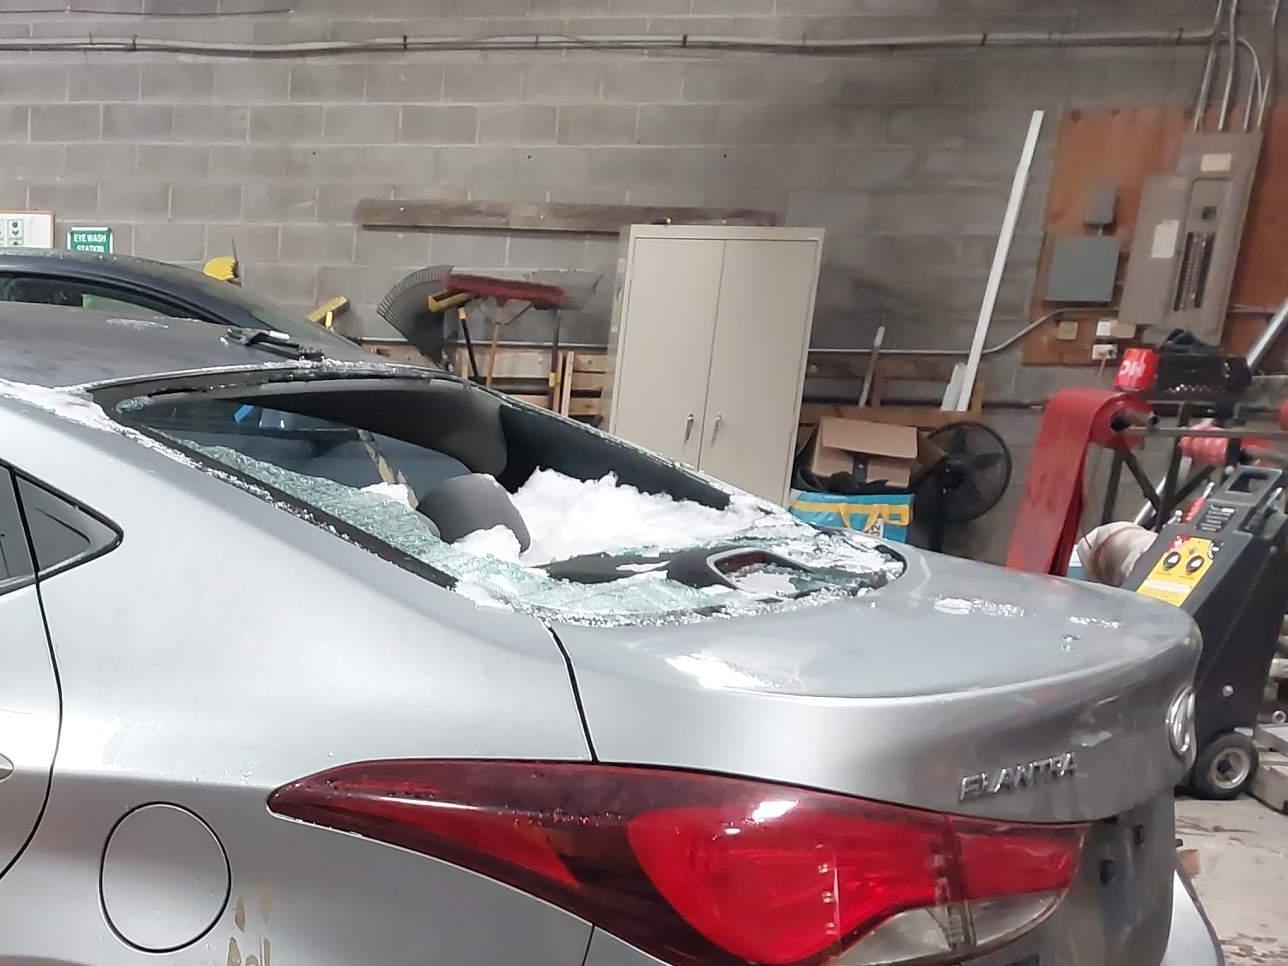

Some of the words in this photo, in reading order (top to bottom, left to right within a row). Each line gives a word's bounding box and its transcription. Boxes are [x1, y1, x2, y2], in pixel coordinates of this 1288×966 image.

[73, 233, 87, 242] EYE
[87, 233, 107, 243] WASH
[959, 751, 1078, 801] ELANTRA
